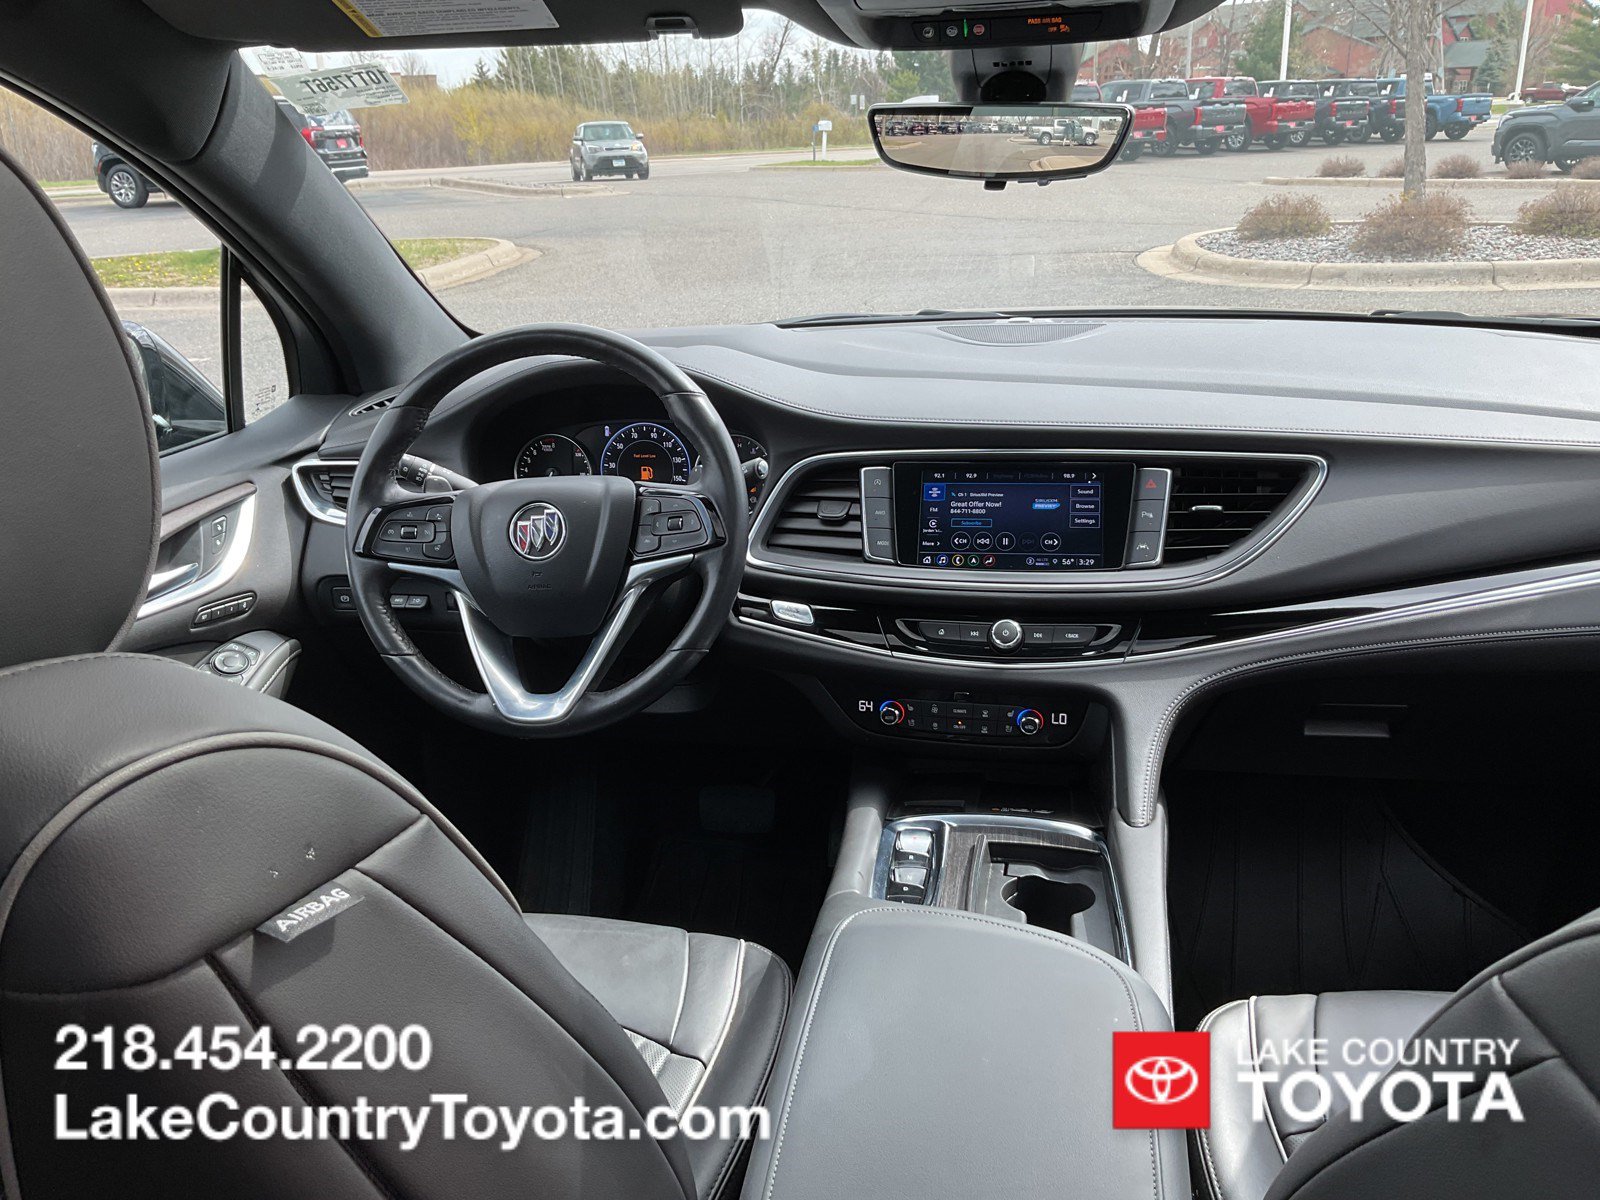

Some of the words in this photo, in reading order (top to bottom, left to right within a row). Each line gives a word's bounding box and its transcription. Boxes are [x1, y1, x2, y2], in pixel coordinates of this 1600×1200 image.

[859, 700, 873, 712] 64
[1051, 713, 1067, 725] LO
[276, 888, 350, 932] AIRBAG
